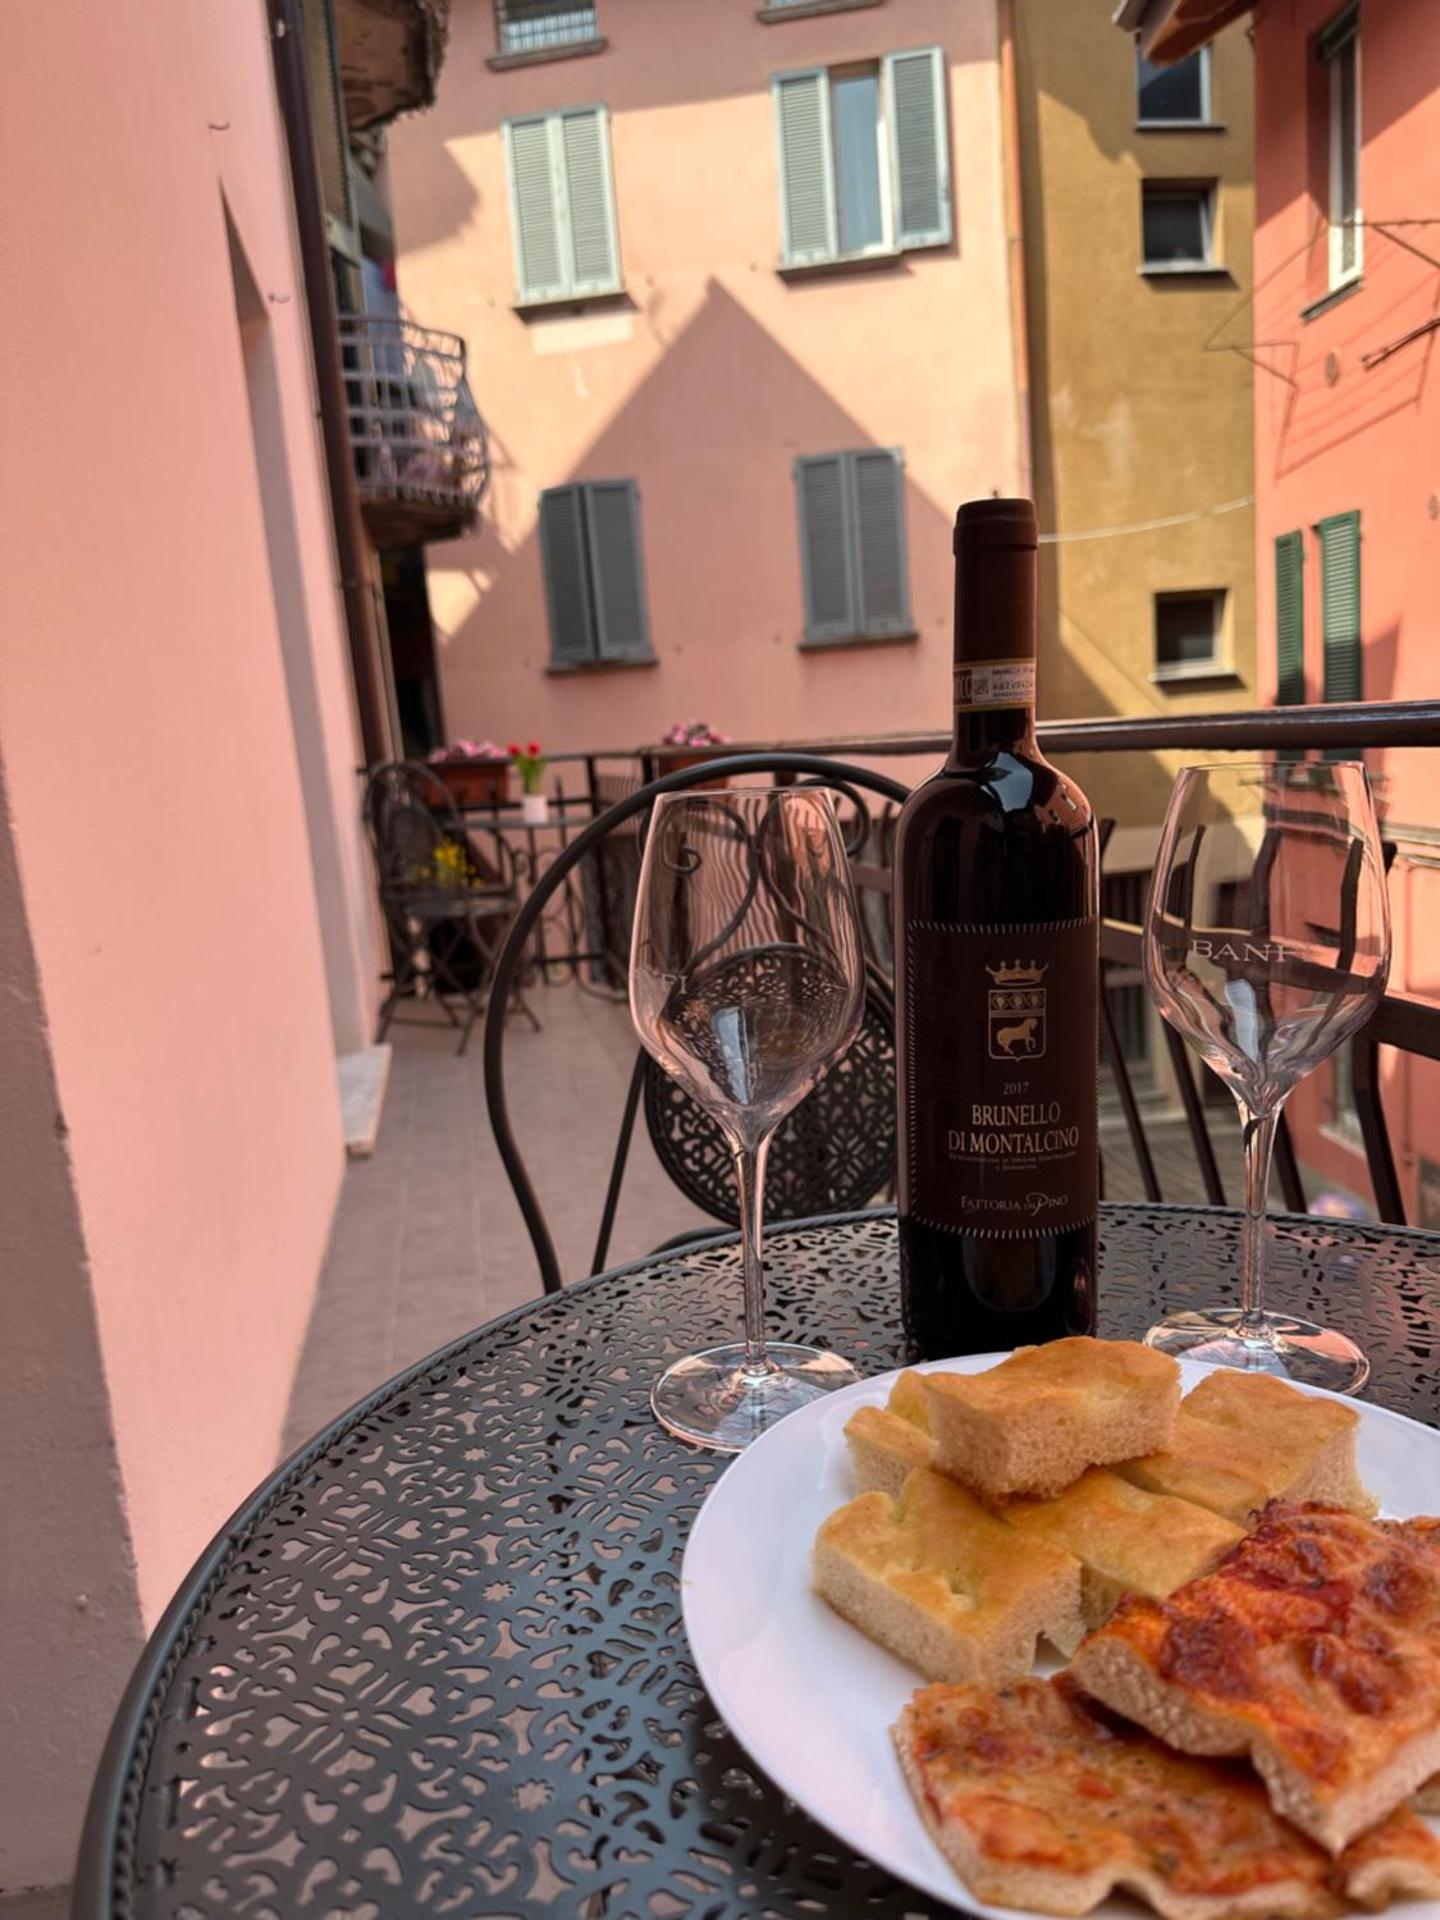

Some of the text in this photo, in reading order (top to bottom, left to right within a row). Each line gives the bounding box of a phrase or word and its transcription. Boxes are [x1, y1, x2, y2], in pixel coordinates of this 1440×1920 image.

[1003, 1081, 1029, 1095] 2017
[972, 1101, 1061, 1126] BRUNELLO
[948, 1126, 1080, 1154] DI MONTALCINO
[960, 1195, 1022, 1211] FATTORIA
